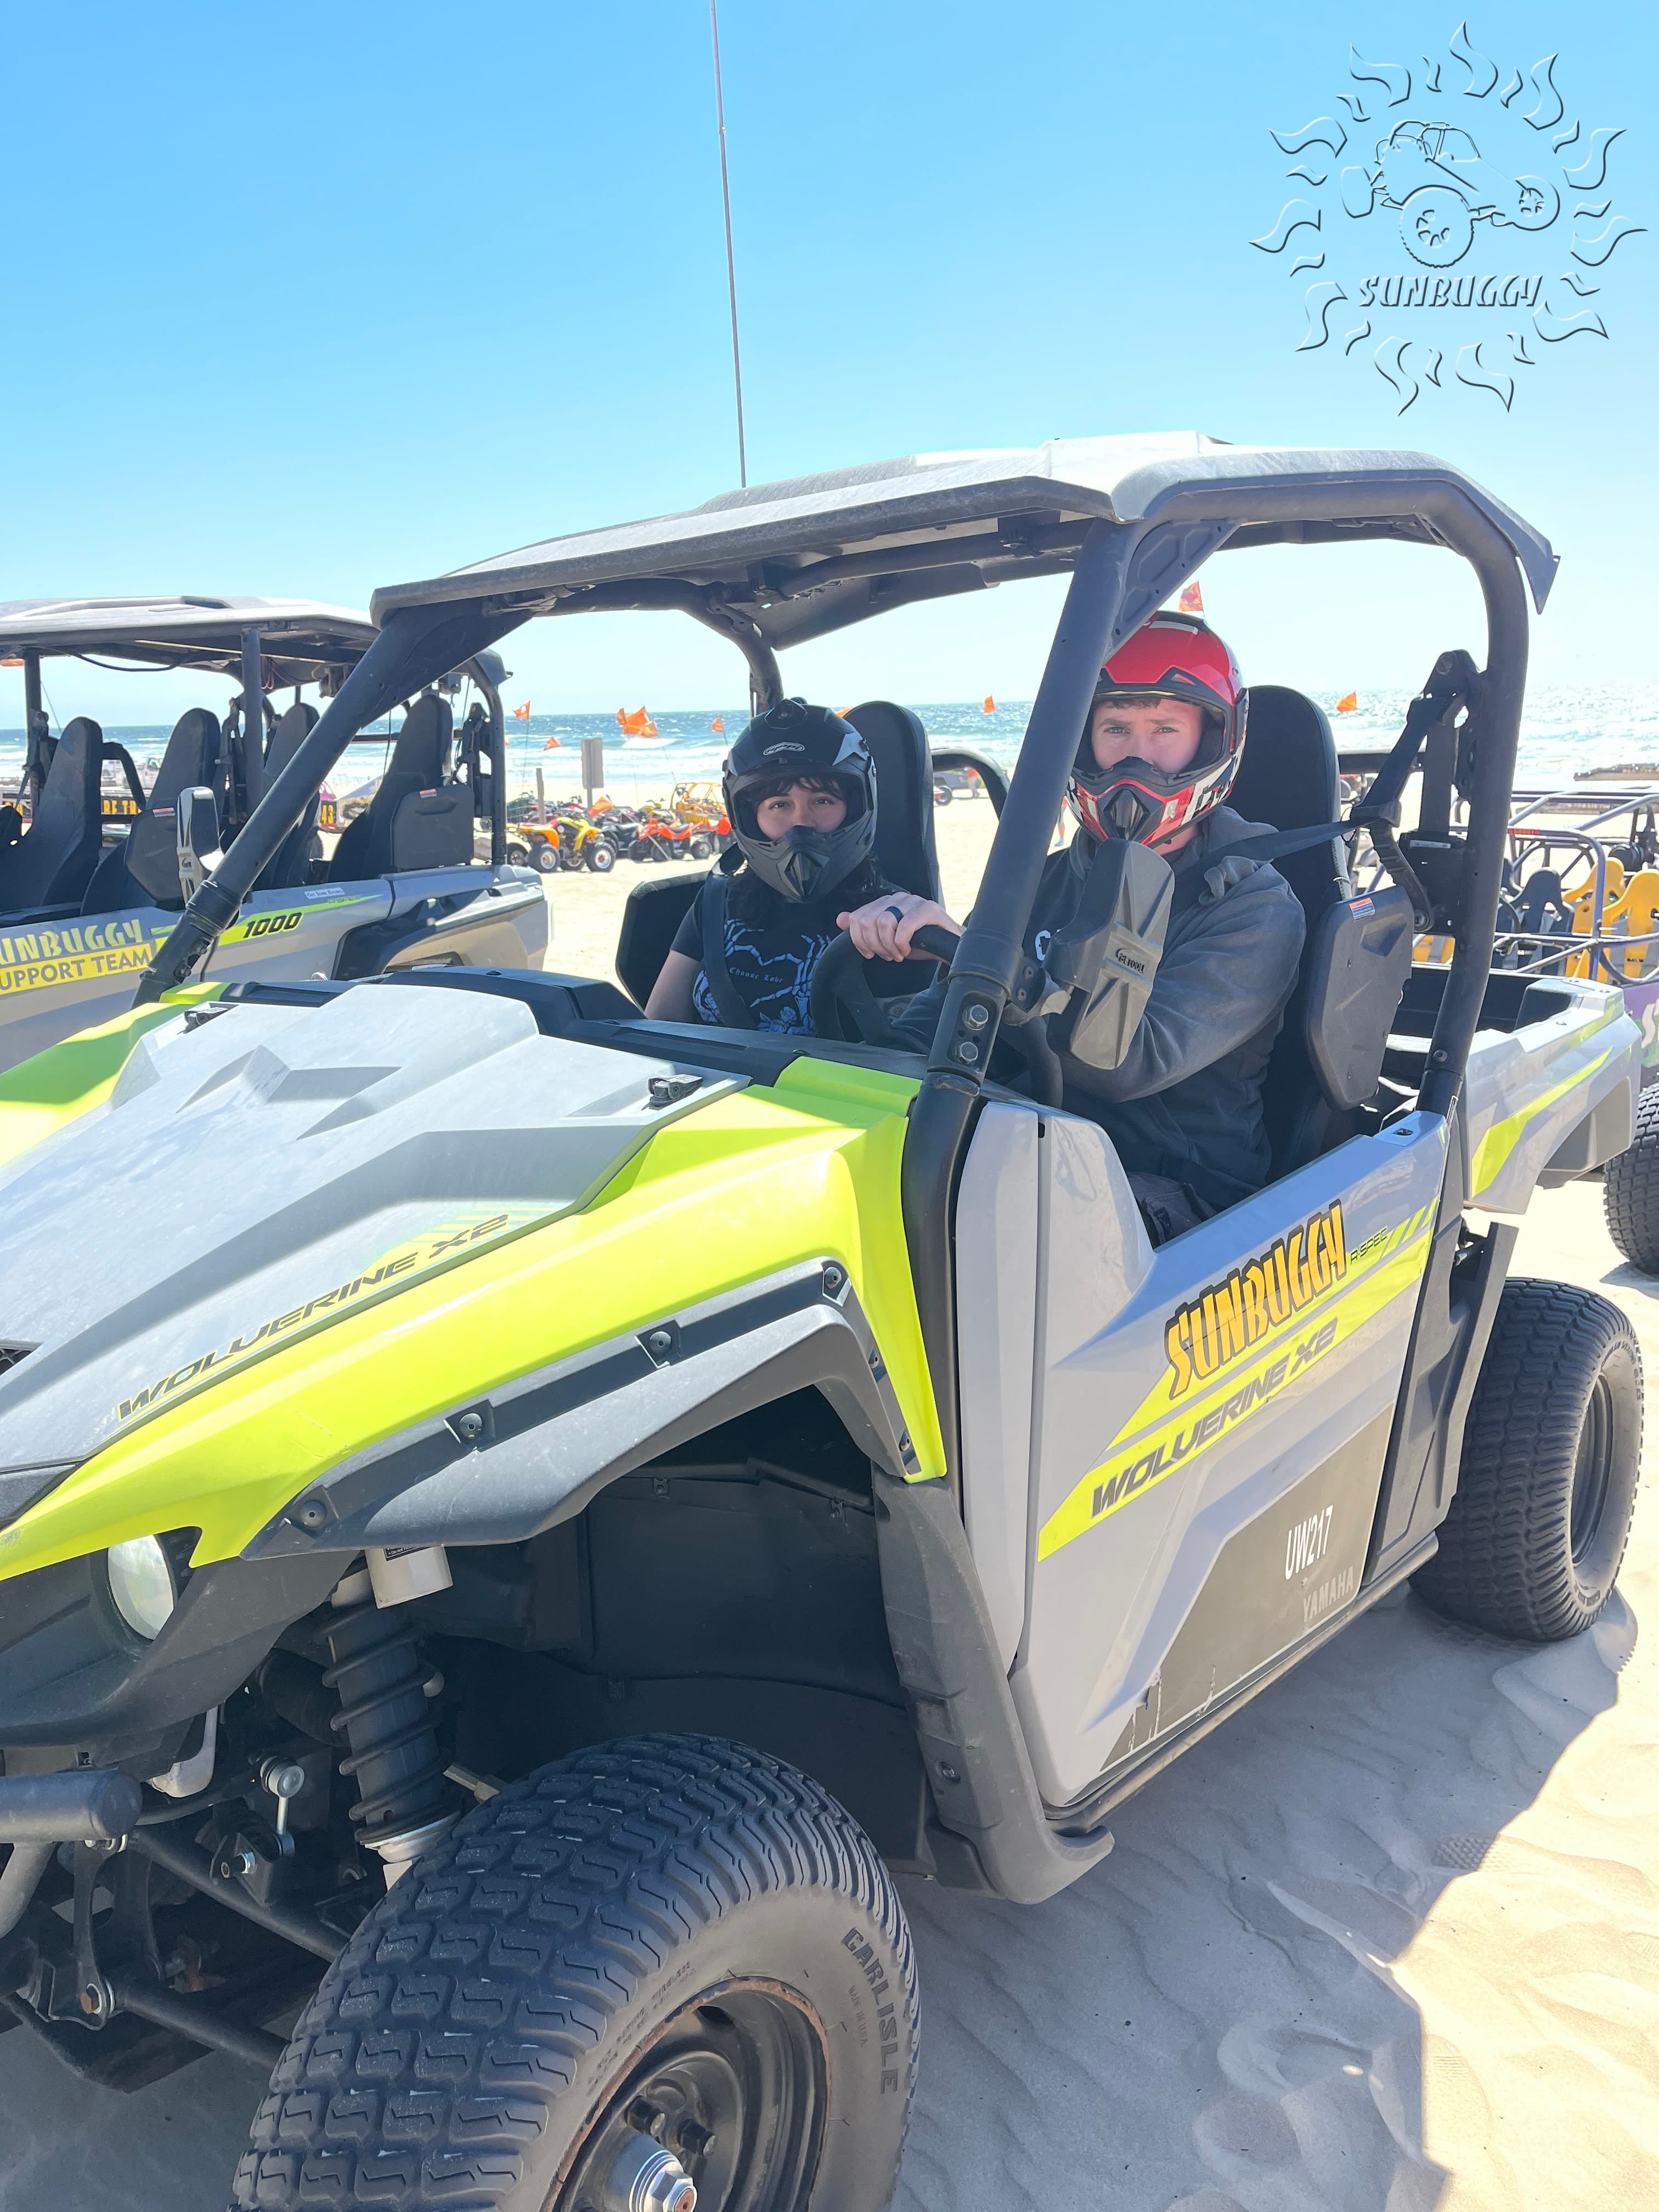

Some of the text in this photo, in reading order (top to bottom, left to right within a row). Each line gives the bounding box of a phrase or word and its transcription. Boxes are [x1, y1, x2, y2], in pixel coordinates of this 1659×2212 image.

[0, 919, 143, 966] UNBUGGY
[243, 912, 302, 938] 1000
[0, 949, 149, 991] UPPORT TEAM
[729, 967, 784, 984] Choose Love
[428, 1214, 509, 1259] X2
[1165, 1200, 1346, 1399] SUNBUGGY
[1289, 1317, 1338, 1377] X2
[1285, 1504, 1333, 1580] UW217
[1303, 1565, 1353, 1623] YAMAHA
[841, 1927, 899, 2095] CARLISLE
